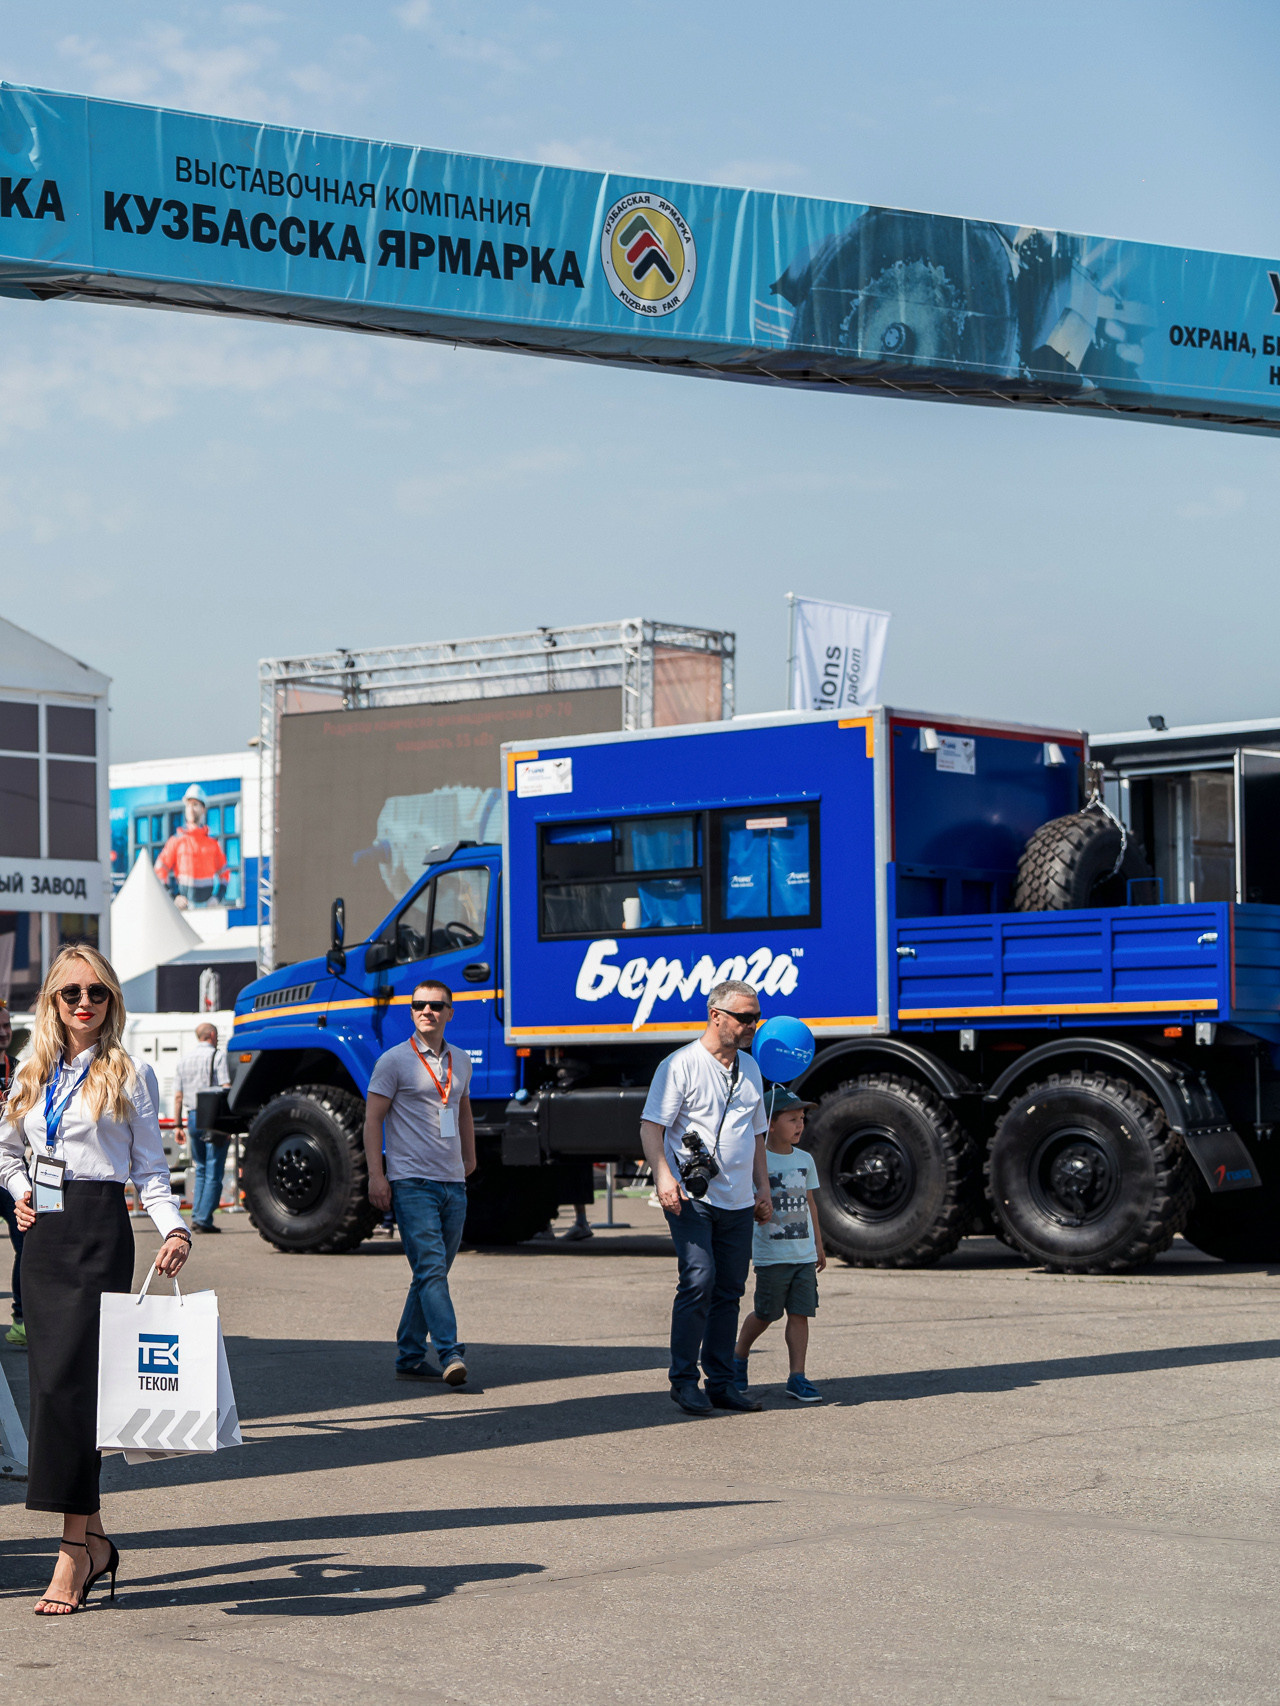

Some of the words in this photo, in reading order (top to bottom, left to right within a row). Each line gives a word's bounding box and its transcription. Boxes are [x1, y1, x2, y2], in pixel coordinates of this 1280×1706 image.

[175, 156, 376, 209] ВЫСТАВОЧНАЯ
[385, 185, 531, 228] КОМПАНИЯ
[103, 190, 366, 265] КУЗБАССКА
[377, 229, 585, 289] ЯРМАРКА
[605, 196, 651, 235] КУЗБАССКАЯ
[658, 201, 691, 244] ЯРМАРКА
[619, 290, 657, 314] KUZBASS
[662, 295, 681, 312] FAIR
[1169, 324, 1257, 359] ОХРАНА,
[1262, 334, 1280, 357] Б
[814, 645, 842, 710] ions
[31, 876, 87, 900] ЗАВОД
[575, 938, 799, 1032] Берлога
[780, 1197, 805, 1205] FEAR
[138, 1376, 179, 1392] ТЕКОМ
